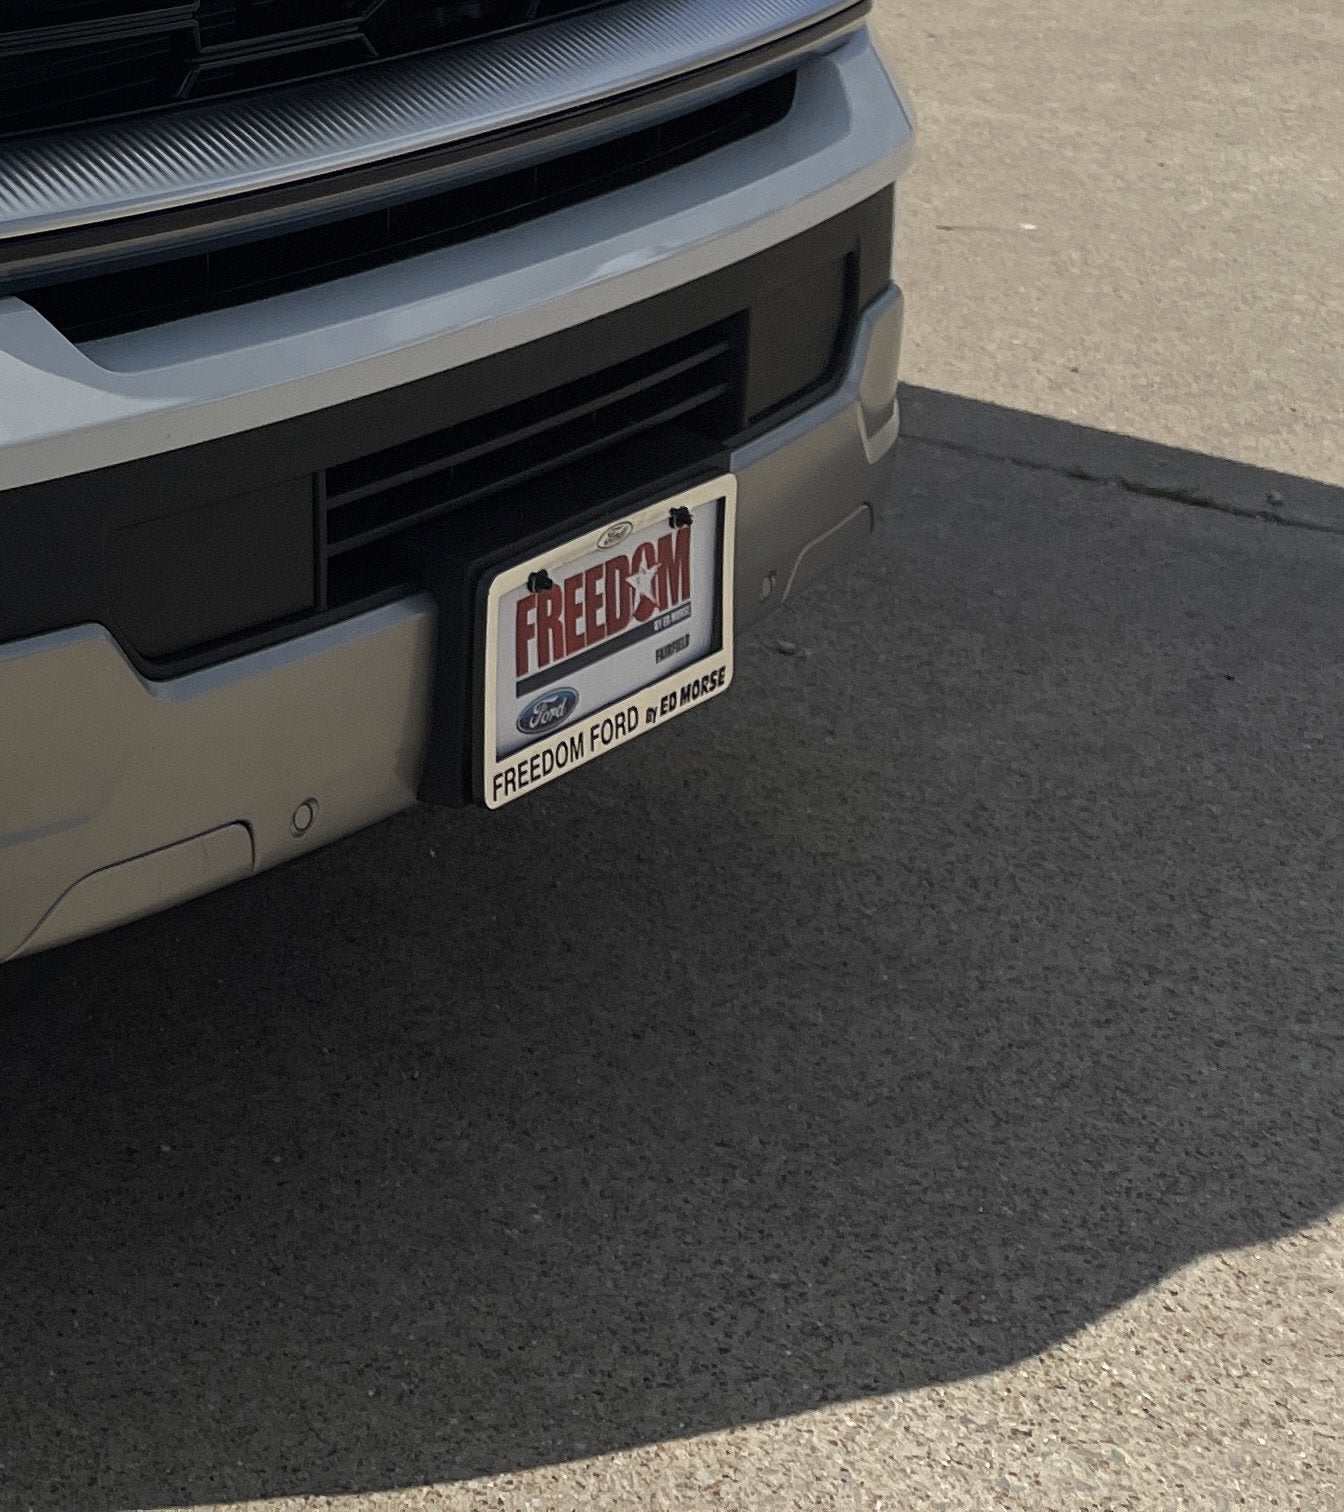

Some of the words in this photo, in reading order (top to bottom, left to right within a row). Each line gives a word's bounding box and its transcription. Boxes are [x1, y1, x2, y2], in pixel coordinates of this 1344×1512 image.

[516, 525, 691, 678] FREEDOM
[492, 732, 584, 802] FREEDOM
[590, 705, 639, 753] FORD
[660, 691, 677, 717] ED
[680, 665, 726, 707] MORSE
[529, 695, 568, 728] Ford
